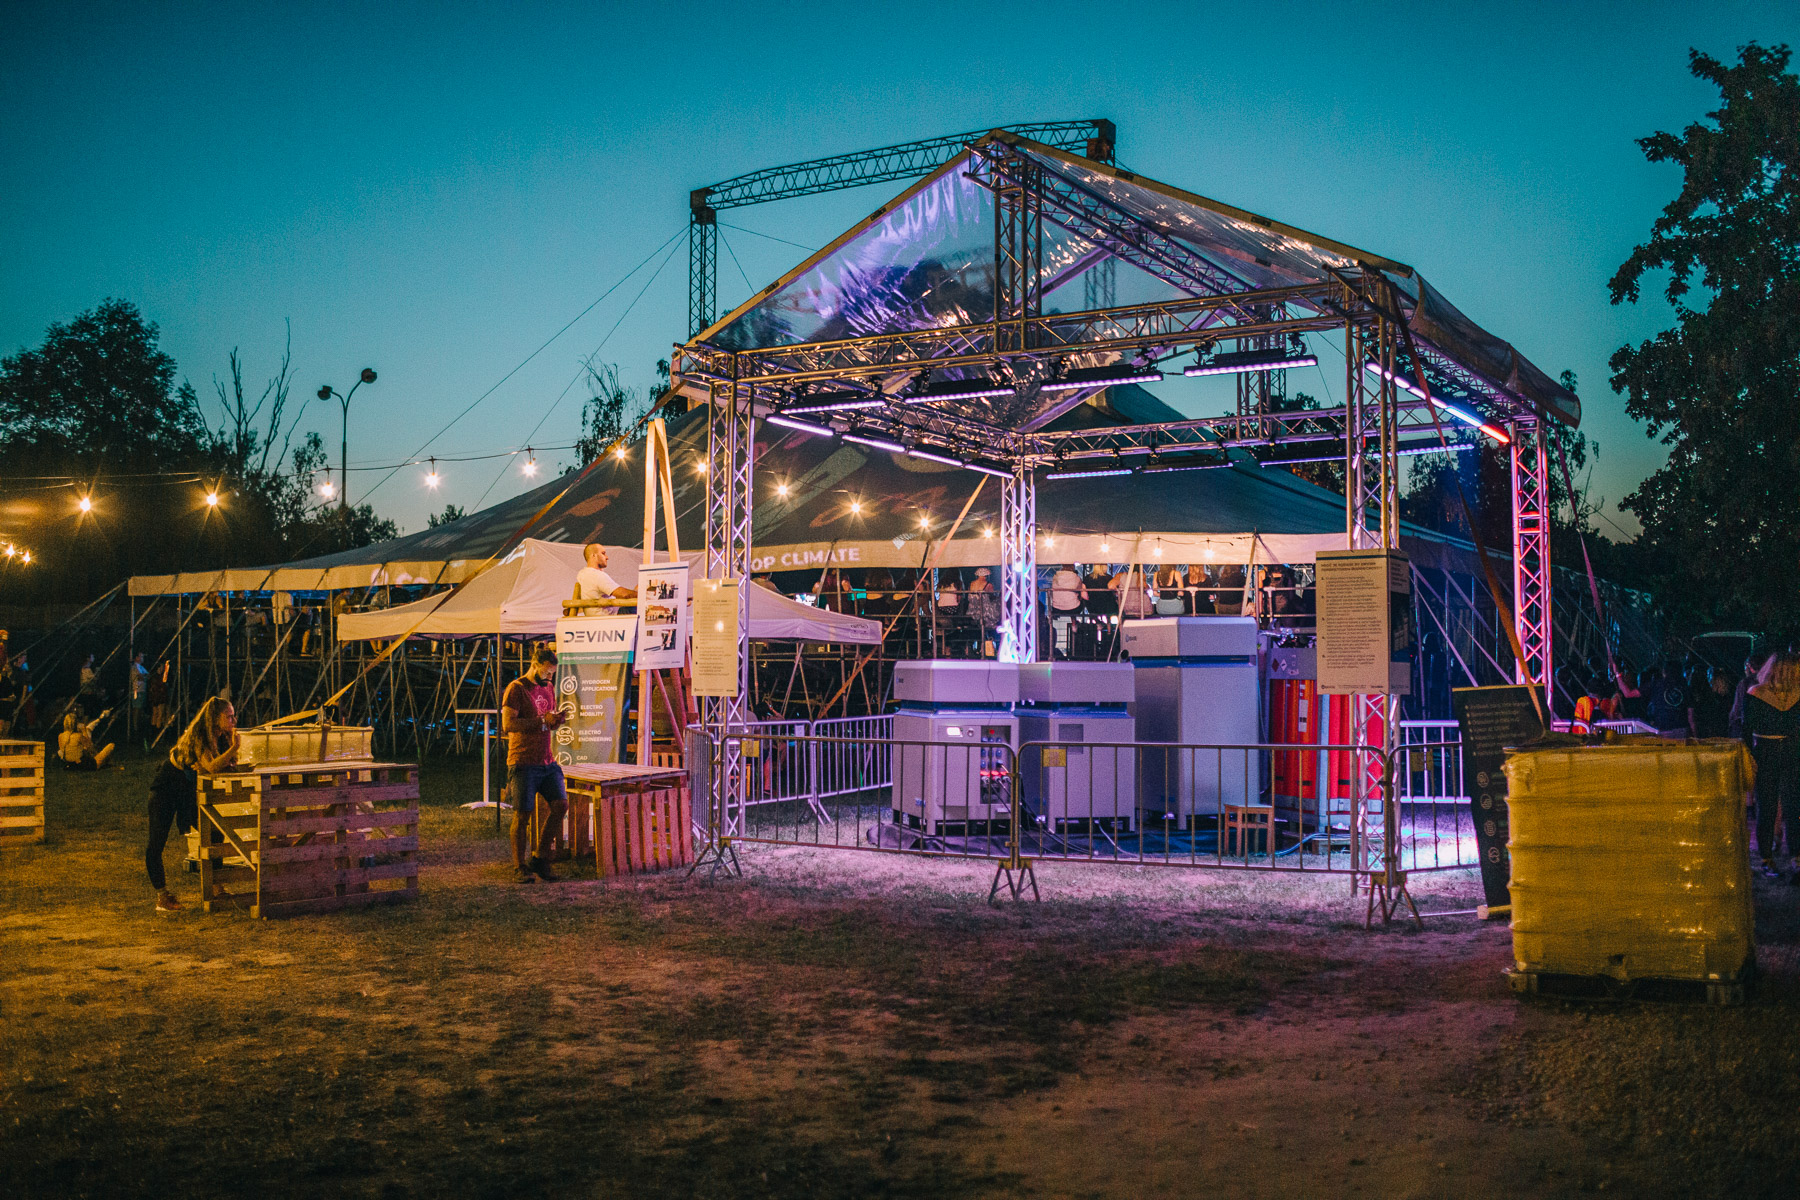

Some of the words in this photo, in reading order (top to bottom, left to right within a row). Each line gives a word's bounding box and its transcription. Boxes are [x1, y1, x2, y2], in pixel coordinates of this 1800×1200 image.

[750, 556, 776, 571] OP
[781, 548, 860, 566] CLIMATE
[564, 630, 625, 643] DEVINN
